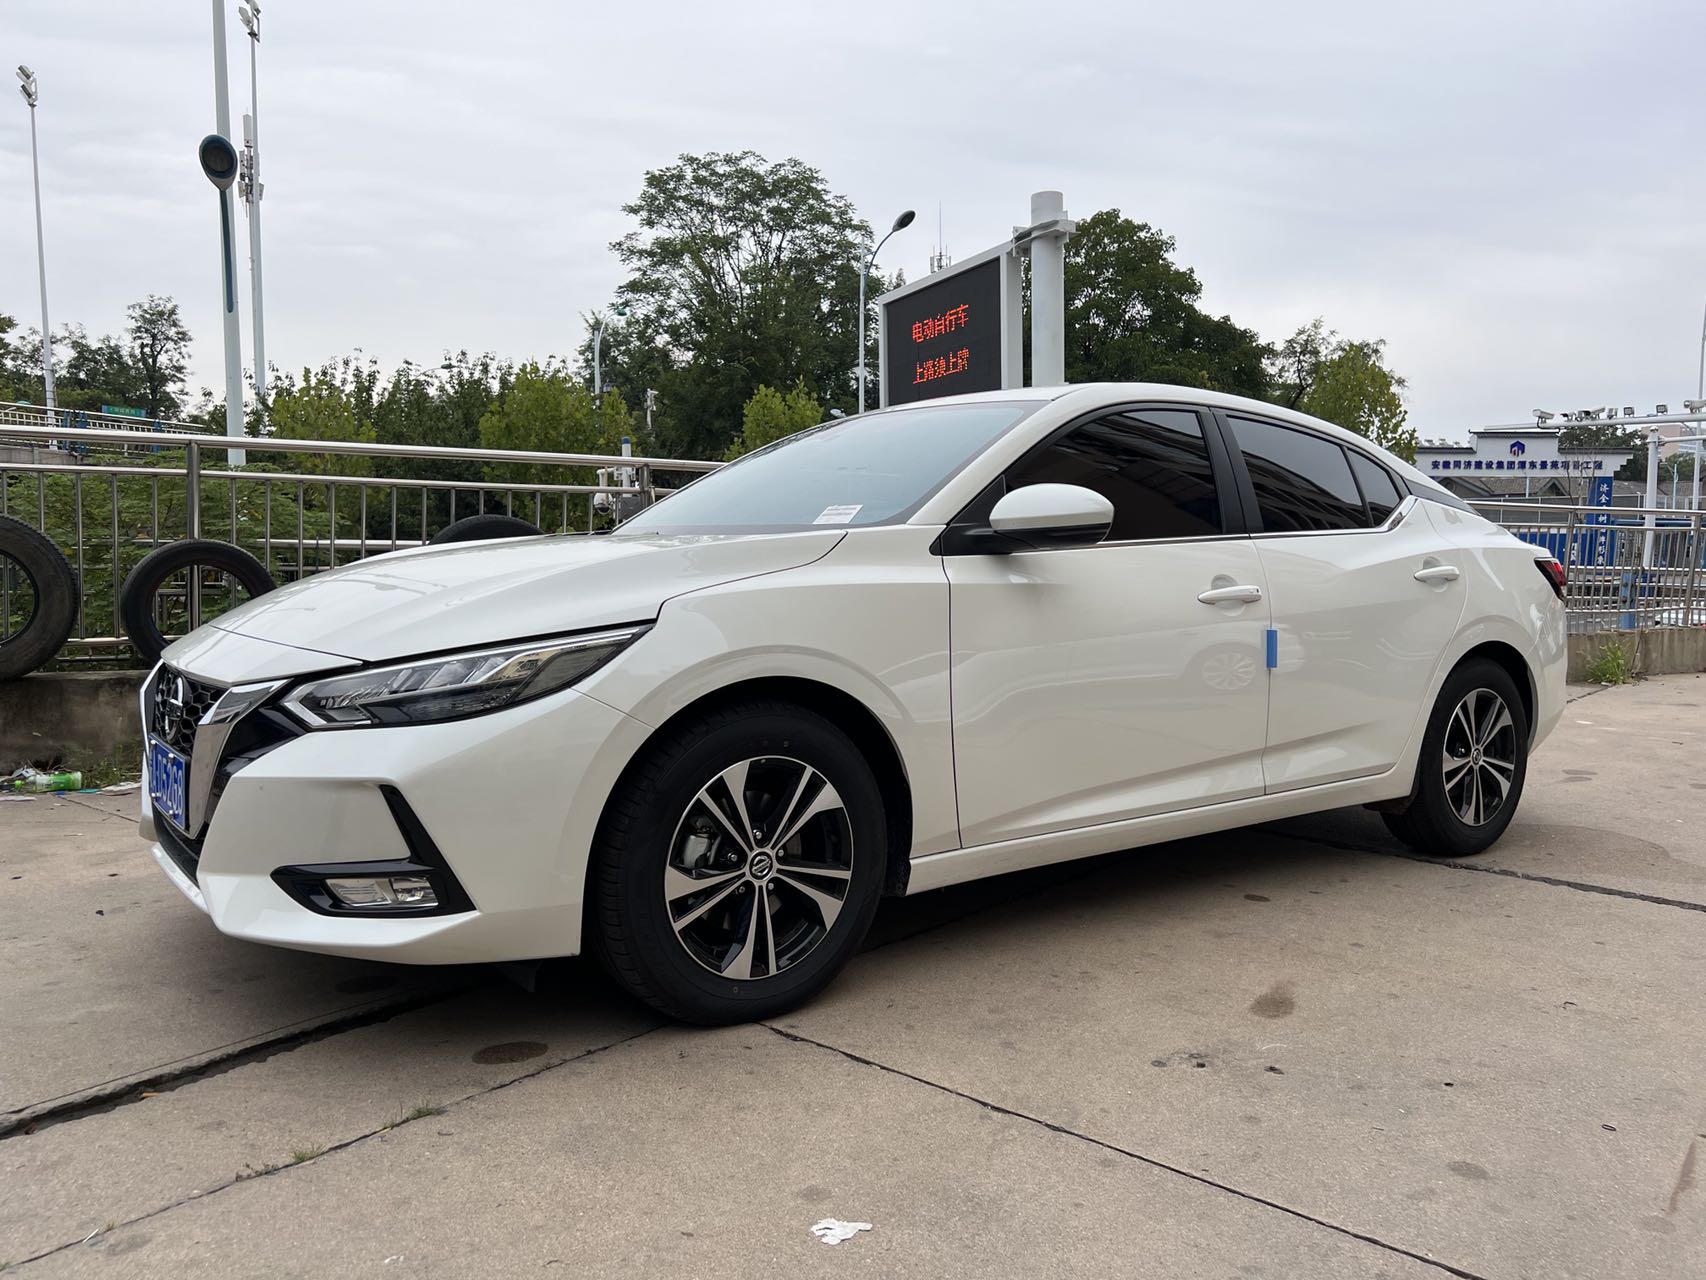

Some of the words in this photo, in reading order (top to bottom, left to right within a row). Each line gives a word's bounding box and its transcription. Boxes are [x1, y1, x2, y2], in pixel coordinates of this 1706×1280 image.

[911, 303, 969, 343] 电动自行车
